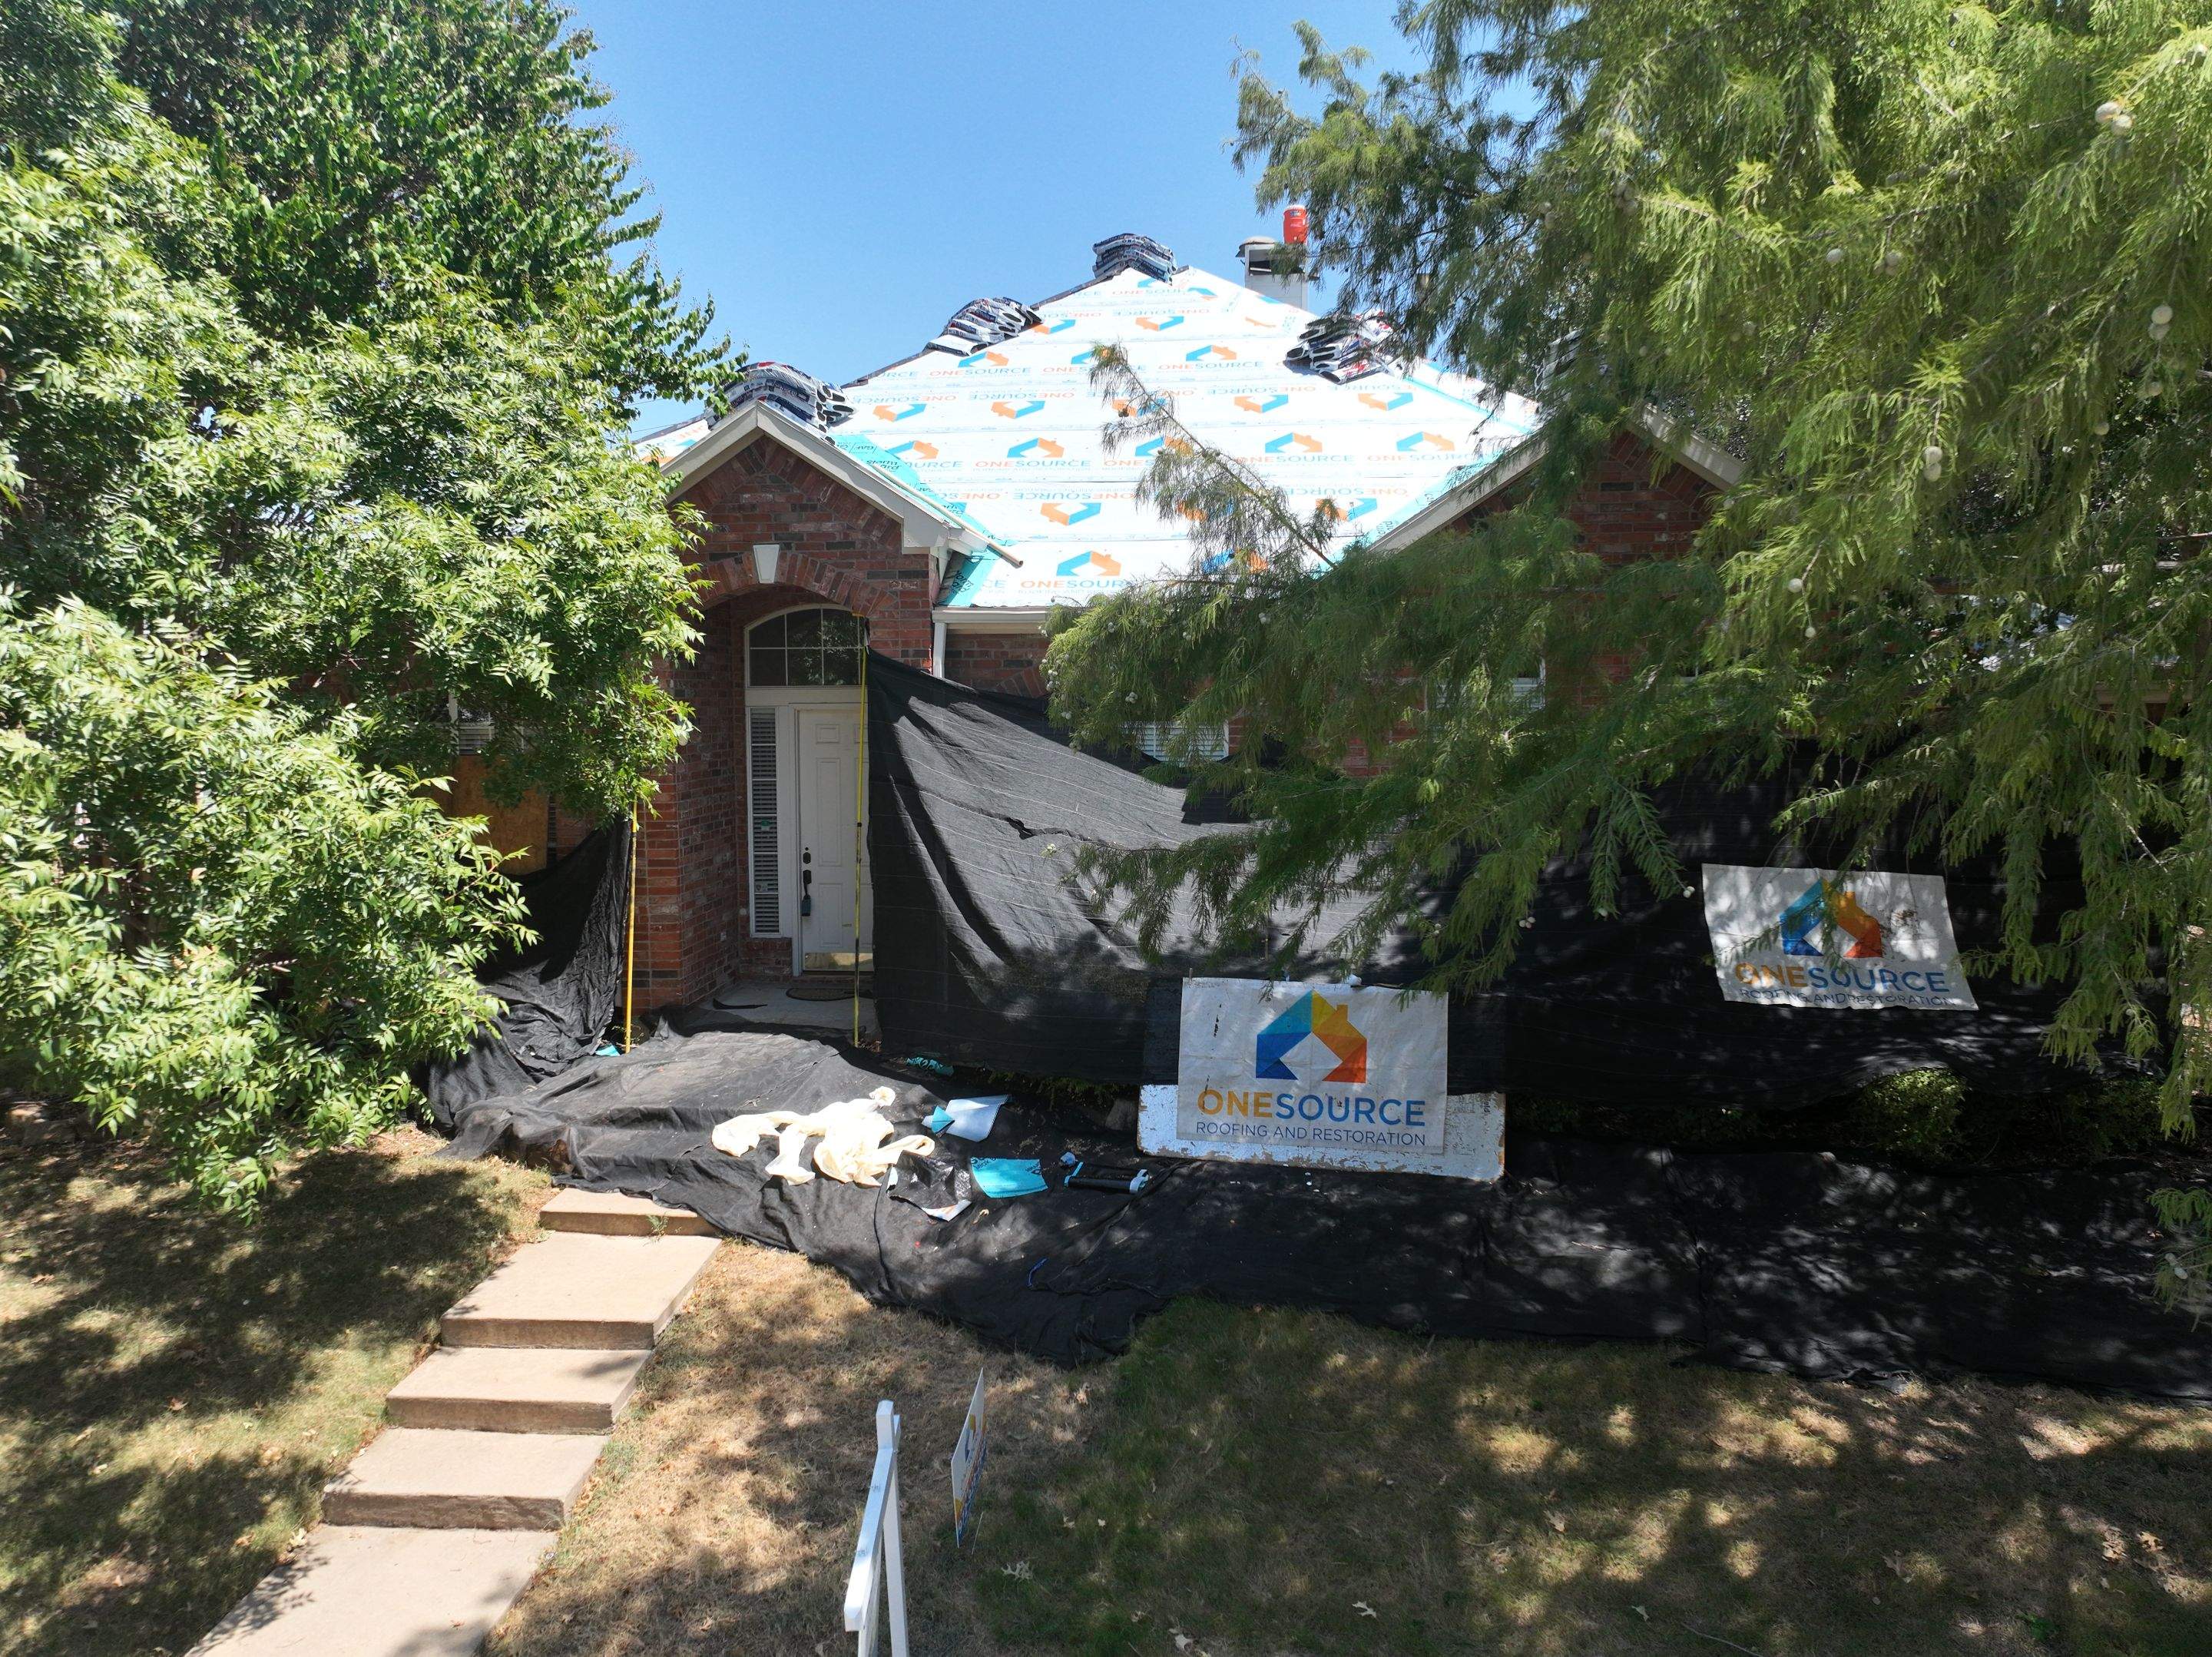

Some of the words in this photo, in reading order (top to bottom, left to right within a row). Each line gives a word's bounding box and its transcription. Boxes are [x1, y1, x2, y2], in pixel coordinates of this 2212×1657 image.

[929, 367, 1031, 376] ONESOURCE
[1158, 362, 1265, 370] ONESOURCE
[1735, 963, 1949, 993] ONESOURCE
[1814, 993, 1846, 1003] AND
[1197, 1089, 1426, 1127] ONESOURCE
[1196, 1122, 1267, 1137] ROOFING
[1273, 1126, 1307, 1139] AND
[1313, 1128, 1426, 1146] RESTORATION
